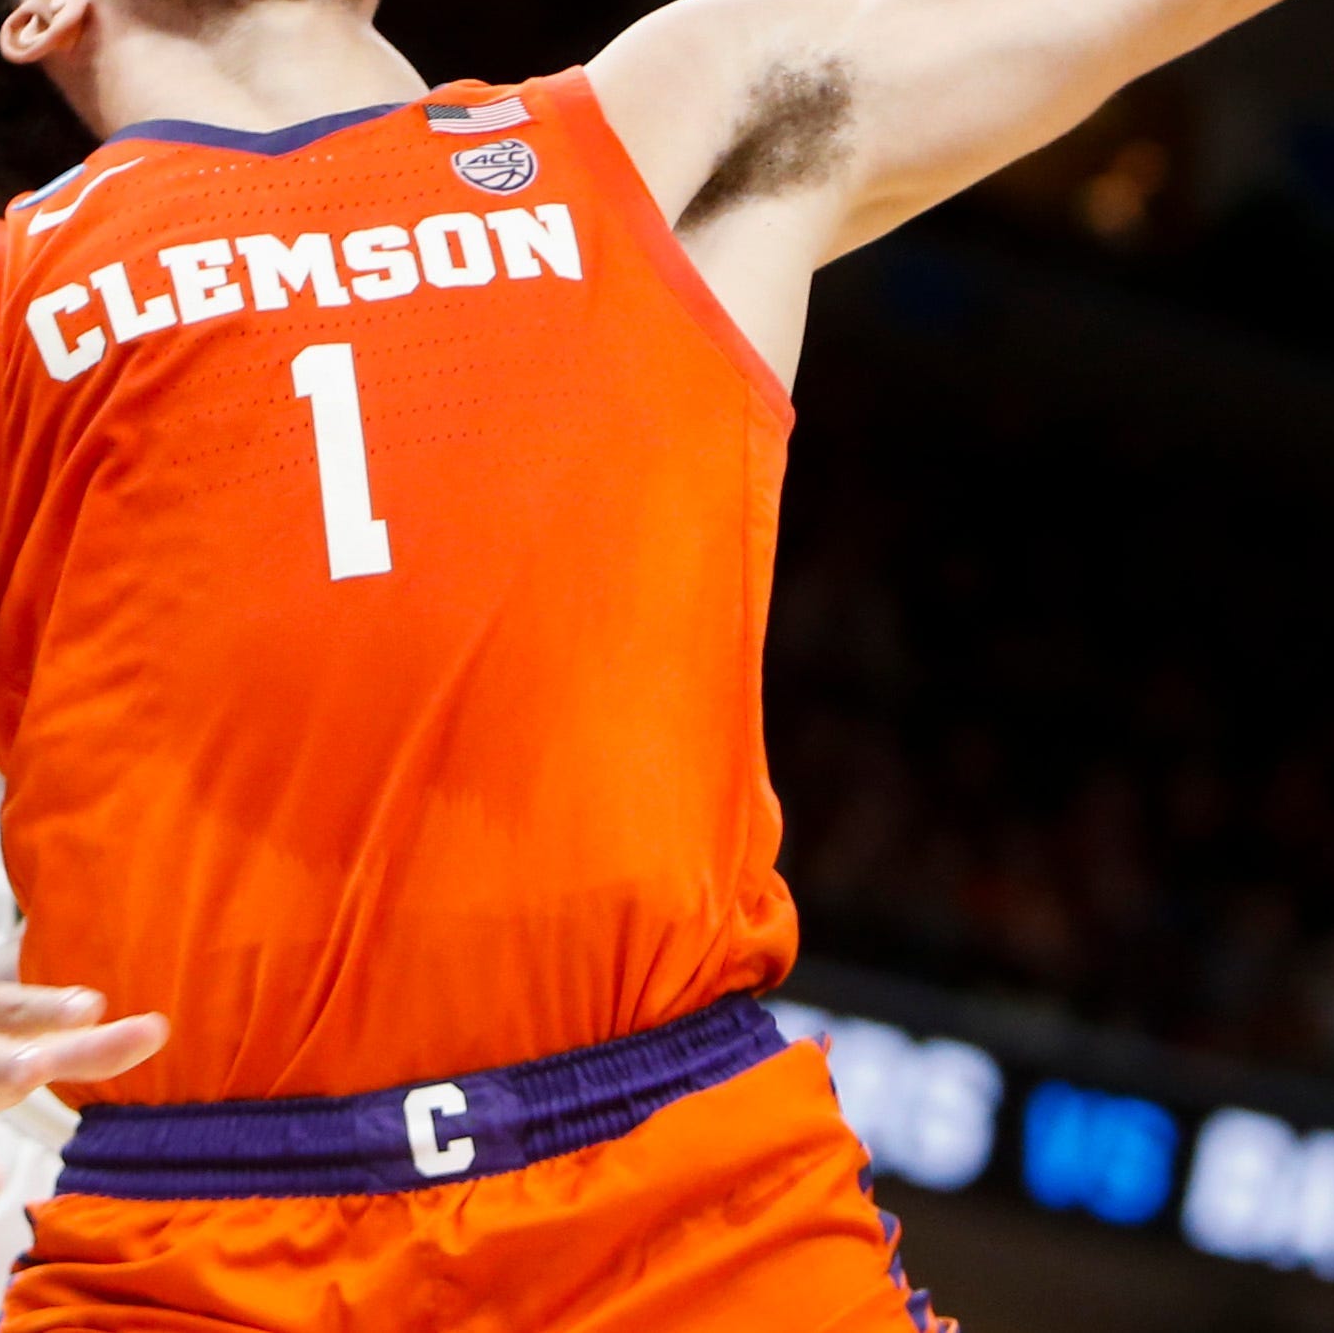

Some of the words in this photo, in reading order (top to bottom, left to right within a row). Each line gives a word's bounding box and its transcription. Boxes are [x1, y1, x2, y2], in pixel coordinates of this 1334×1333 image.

[468, 149, 526, 165] ACC
[24, 202, 583, 382] CLEMSON
[290, 342, 392, 581] 1
[402, 1082, 477, 1179] C
